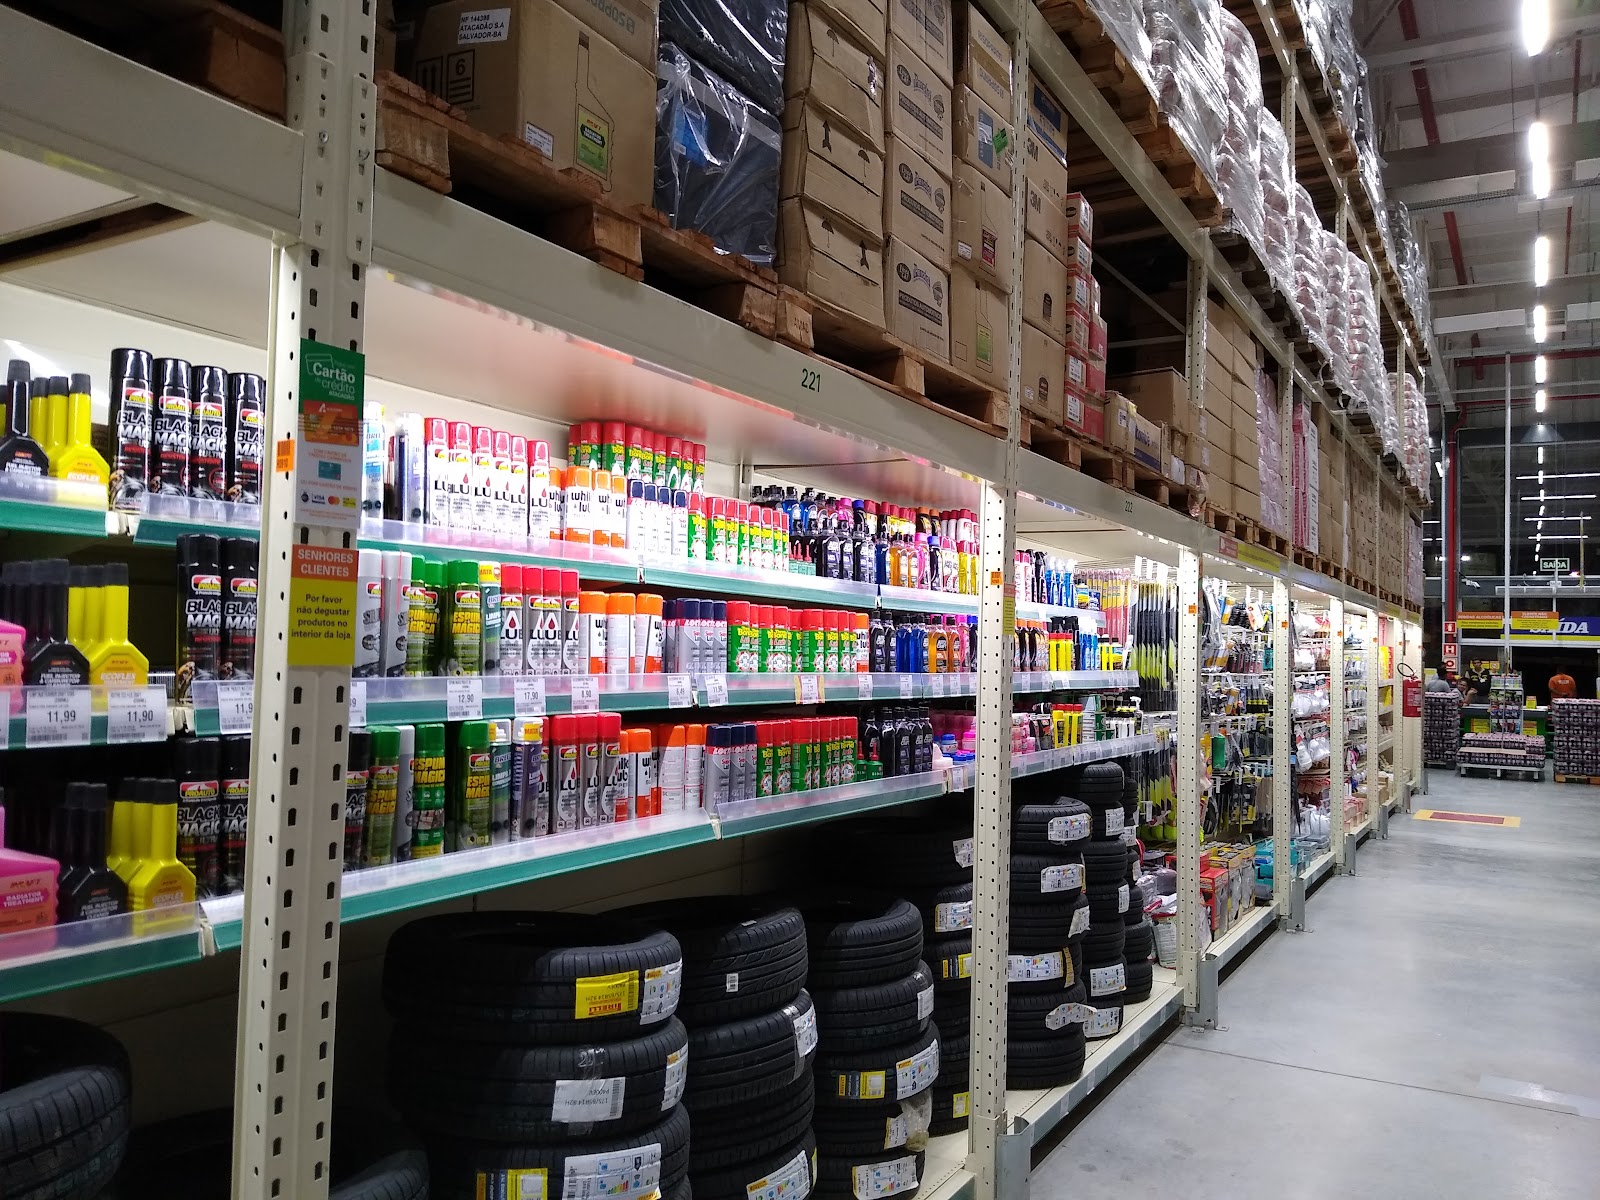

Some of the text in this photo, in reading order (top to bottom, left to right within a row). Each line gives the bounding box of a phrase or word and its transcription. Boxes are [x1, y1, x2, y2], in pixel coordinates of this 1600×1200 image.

[459, 31, 502, 40] SALVADOR-BA
[454, 58, 466, 76] 6
[1027, 138, 1039, 161] 3M
[1030, 190, 1041, 213] 3M
[313, 362, 355, 384] Cartão
[801, 368, 820, 392] 221
[322, 380, 355, 394] crédito
[192, 424, 228, 439] LACK
[298, 549, 354, 564] SENHORES
[300, 564, 349, 576] CLIENTES
[306, 594, 342, 604] Por favor
[296, 606, 350, 616] não degustar
[298, 618, 334, 628] produtos
[292, 629, 352, 640] interior da loja.
[100, 672, 136, 680] ECOFLEX
[458, 694, 474, 703] 12,90
[524, 692, 539, 700] 17,90
[48, 710, 76, 722] 11,99
[127, 710, 154, 722] 11,90
[185, 788, 216, 797] PROAUTO
[6, 890, 42, 900] RADIATOR
[4, 896, 44, 907] TREATMENT
[588, 1002, 622, 1016] PIRELLI
